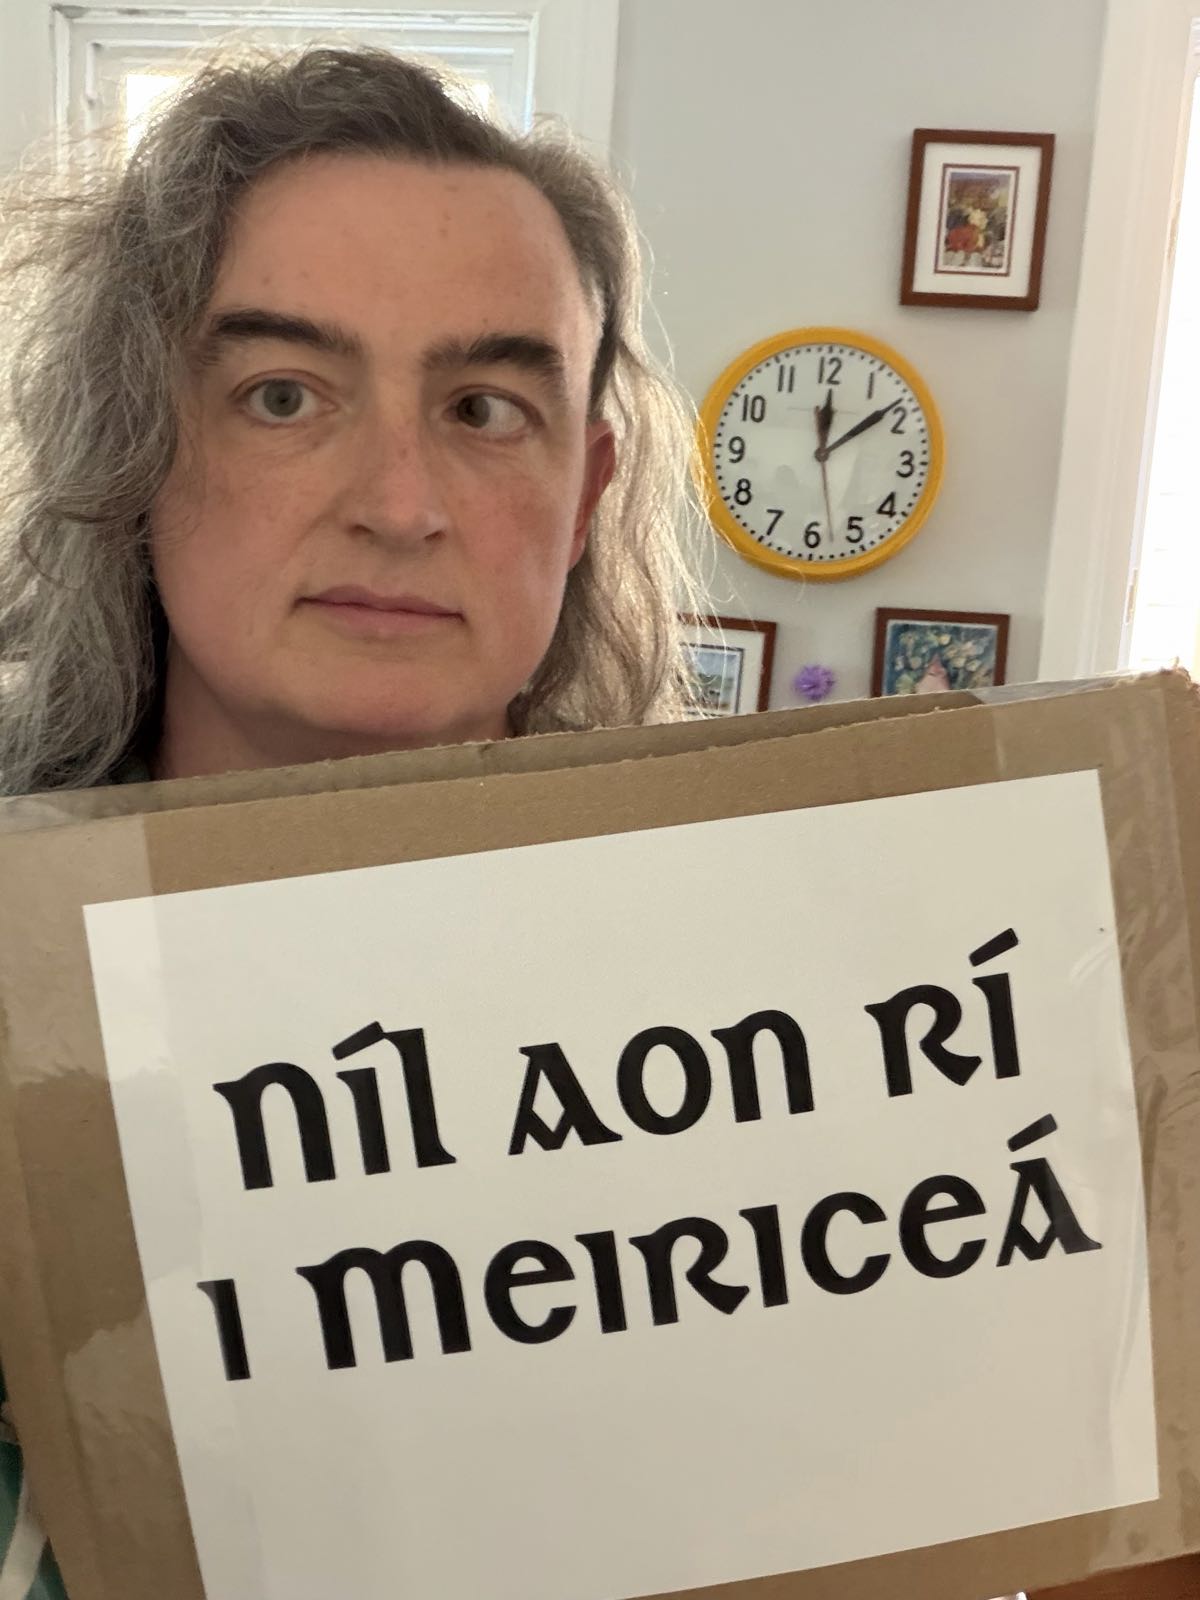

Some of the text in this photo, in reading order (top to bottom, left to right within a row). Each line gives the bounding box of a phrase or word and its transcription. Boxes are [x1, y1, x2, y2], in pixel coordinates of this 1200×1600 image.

[777, 364, 796, 394] 11
[817, 356, 843, 386] 12
[866, 372, 875, 400] 1
[741, 393, 767, 423] 10
[890, 405, 908, 435] 2
[727, 435, 746, 464] 9
[895, 449, 916, 479] 3
[733, 477, 754, 507] 8
[875, 491, 898, 519] 4
[765, 508, 785, 537] 7
[802, 520, 822, 550] 6
[844, 515, 865, 544] 5
